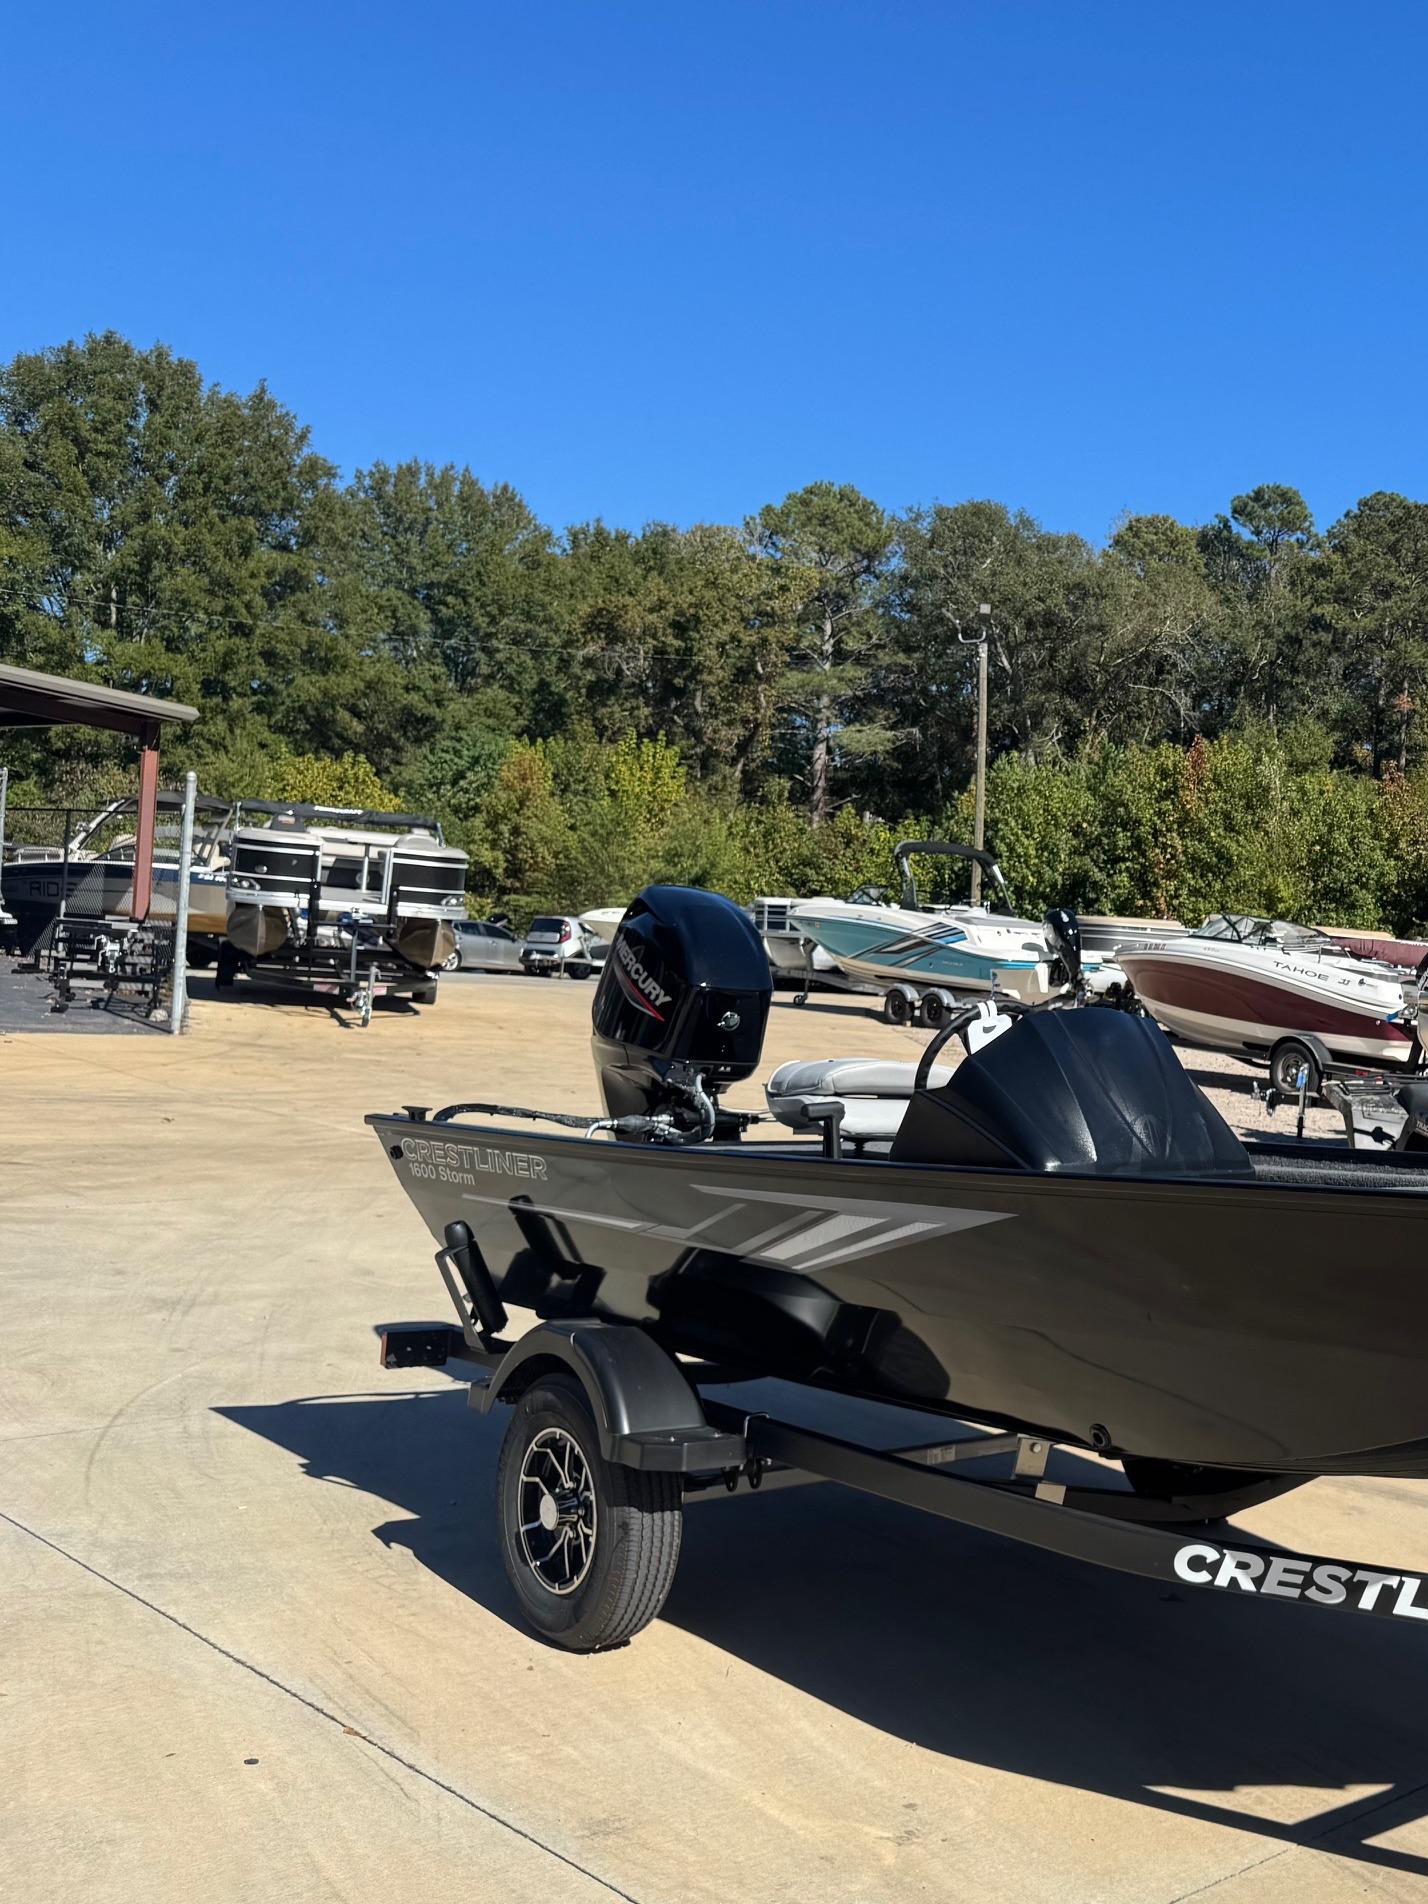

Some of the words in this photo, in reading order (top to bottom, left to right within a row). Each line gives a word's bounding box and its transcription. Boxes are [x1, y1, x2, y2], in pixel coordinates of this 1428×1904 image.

[615, 933, 673, 1007] MERCURY
[1273, 960, 1330, 982] TAHOE
[401, 1137, 548, 1181] CRESTLINER
[409, 1162, 436, 1179] 1600
[439, 1167, 476, 1186] Storm
